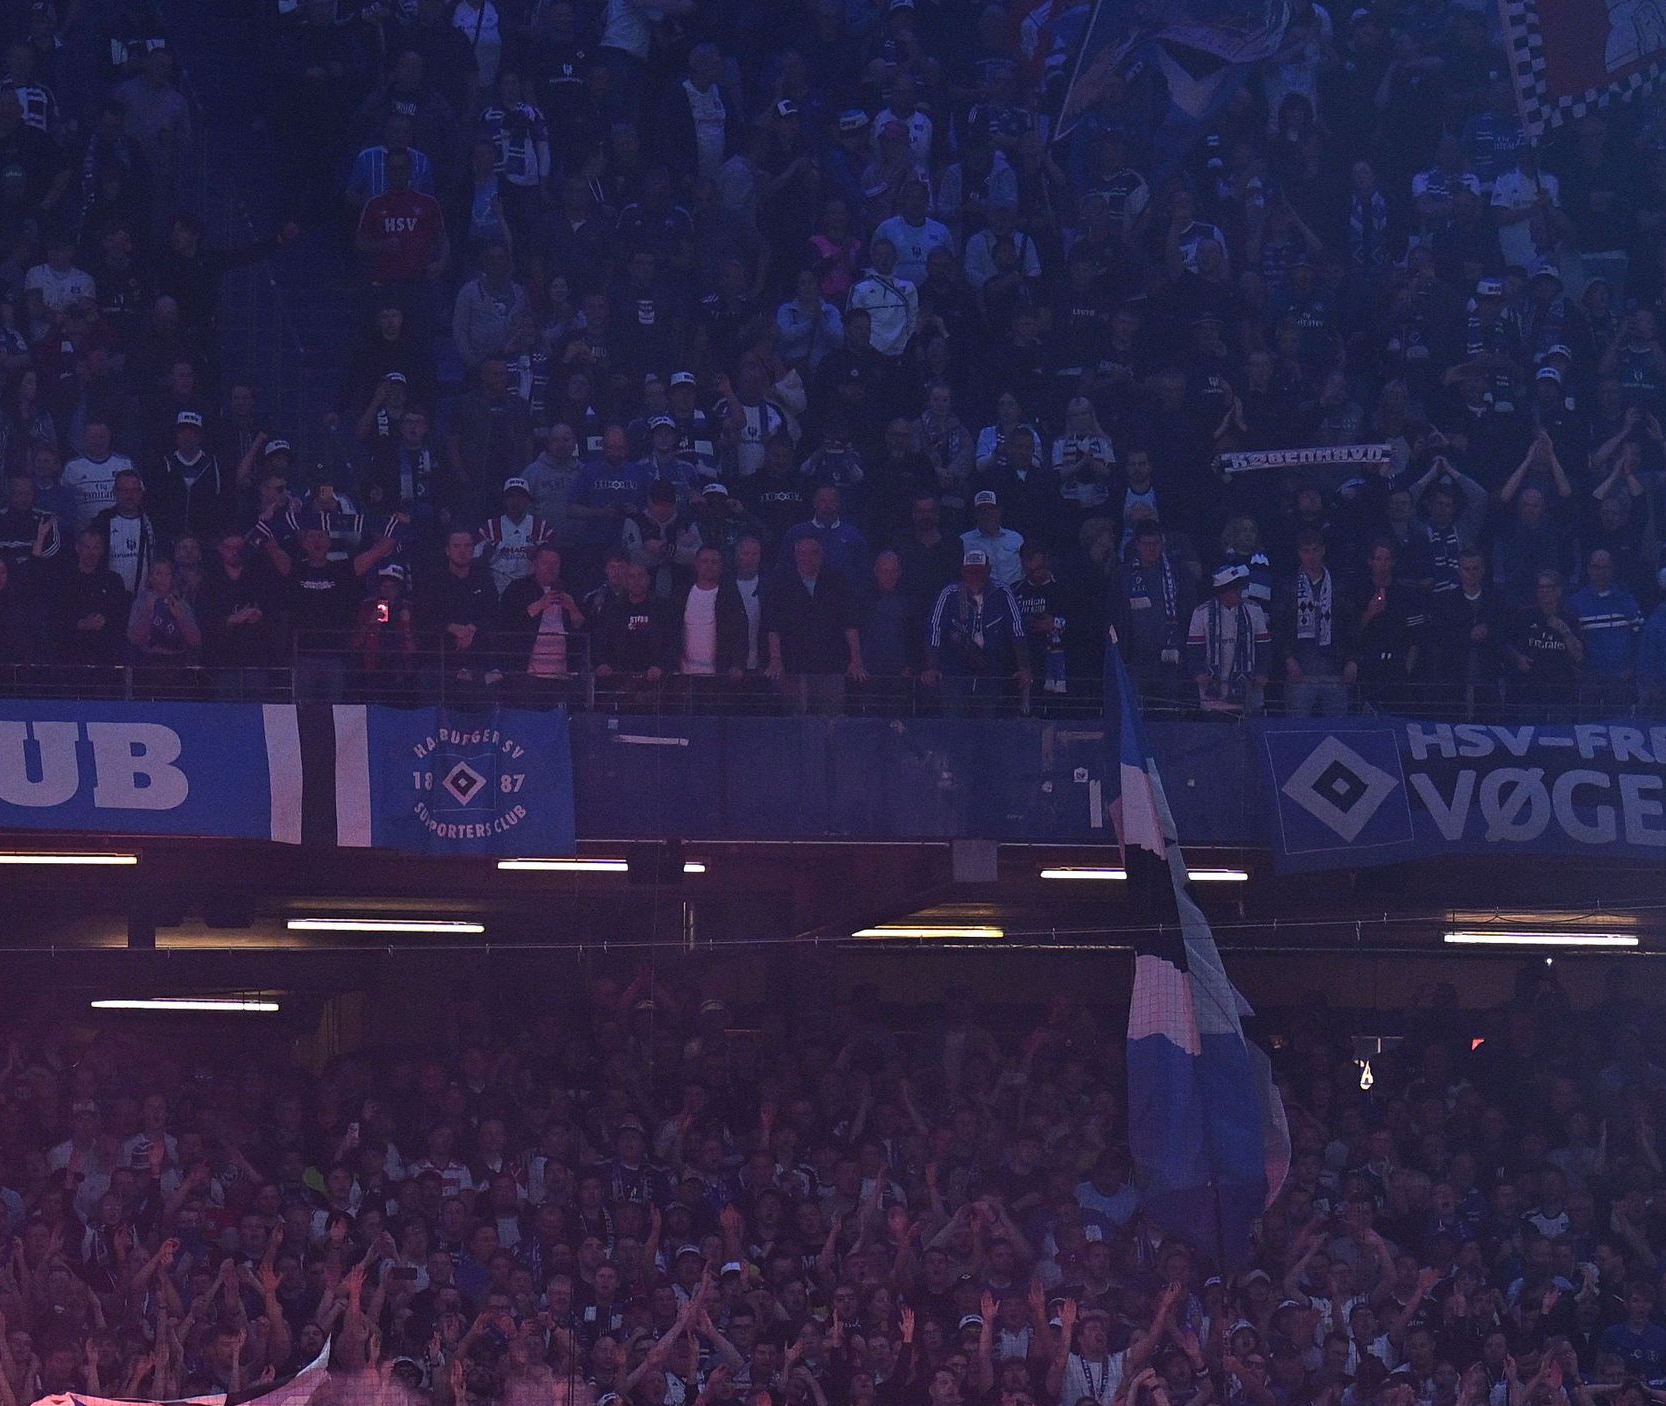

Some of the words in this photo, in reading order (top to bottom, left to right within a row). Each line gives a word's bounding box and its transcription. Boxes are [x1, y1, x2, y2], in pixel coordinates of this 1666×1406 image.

[385, 217, 419, 233] HSV
[501, 739, 526, 760] SV
[412, 771, 434, 791] 18
[500, 773, 526, 794] 87
[493, 803, 527, 833] CLUB
